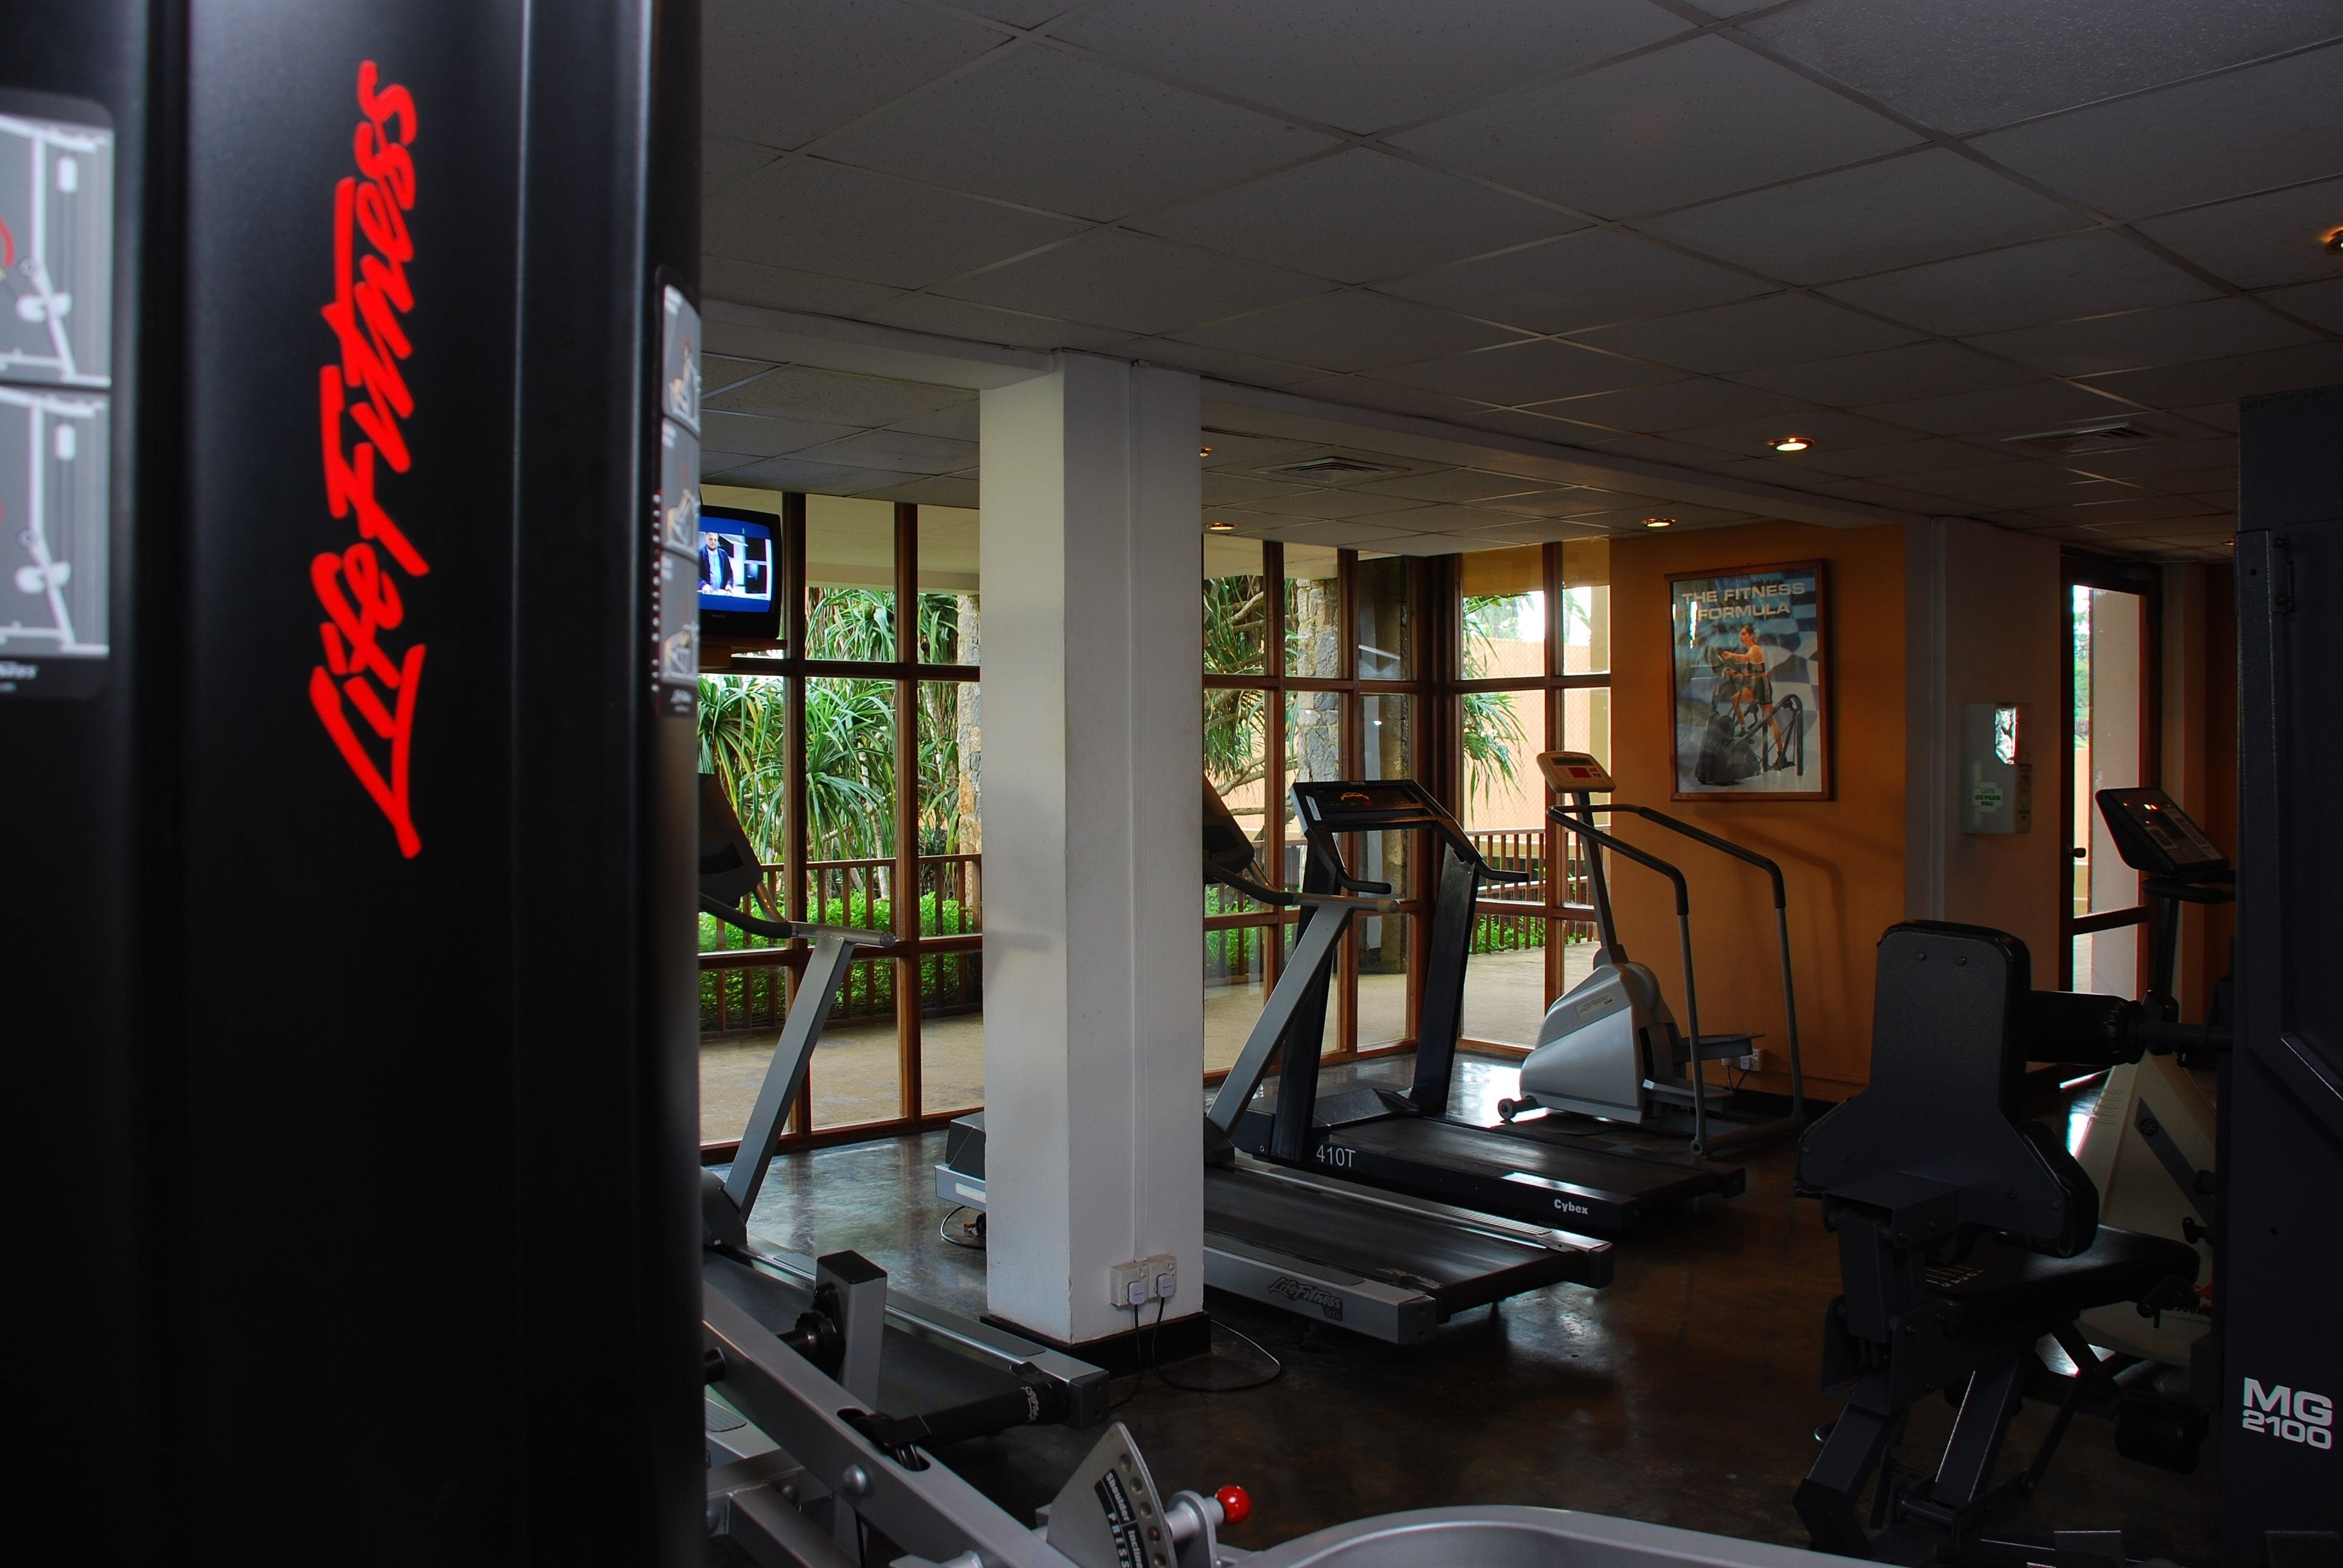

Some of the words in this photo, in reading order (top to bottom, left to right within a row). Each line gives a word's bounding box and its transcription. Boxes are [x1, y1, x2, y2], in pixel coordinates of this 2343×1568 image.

[1682, 591, 1718, 604] THE
[1724, 583, 1806, 602] FITNESS
[1698, 602, 1791, 621] FORMULA
[1316, 1144, 1356, 1168] 410T
[1553, 1198, 1589, 1215] Cybex
[2242, 1376, 2333, 1426] MG
[2242, 1408, 2333, 1450] 2100
[1105, 1472, 1131, 1522] Shoulder
[1107, 1511, 1131, 1568] PRESS
